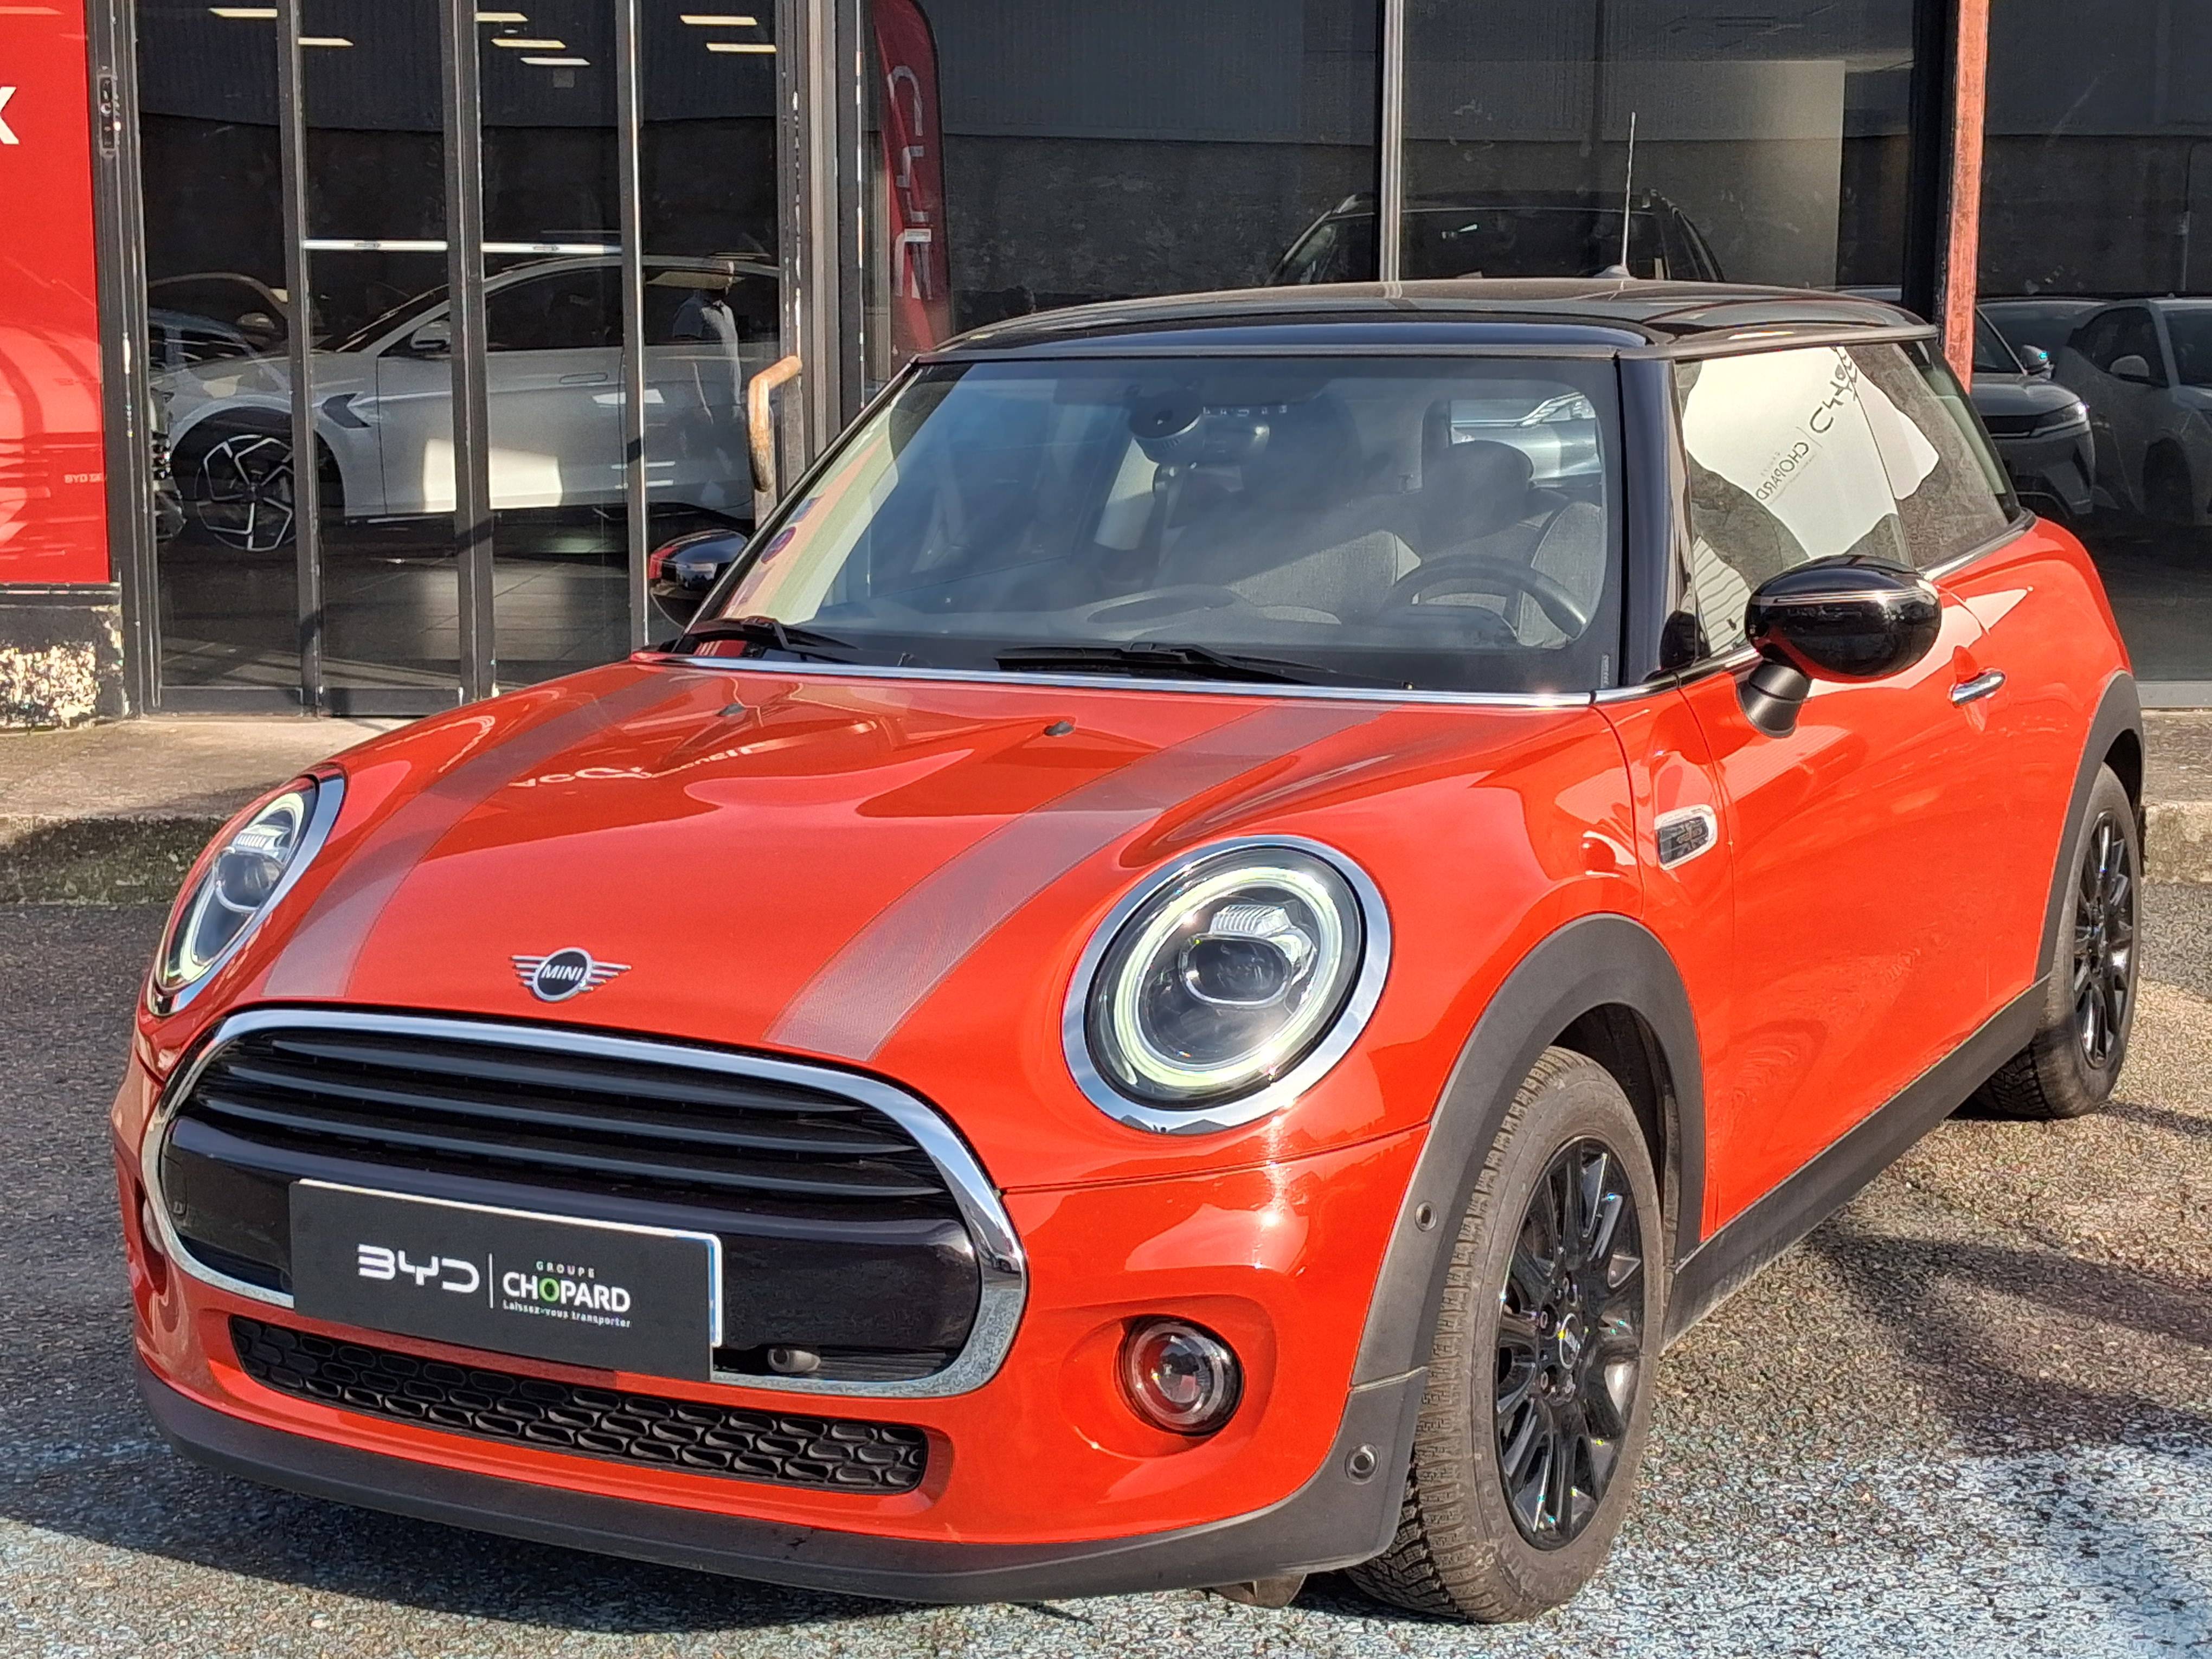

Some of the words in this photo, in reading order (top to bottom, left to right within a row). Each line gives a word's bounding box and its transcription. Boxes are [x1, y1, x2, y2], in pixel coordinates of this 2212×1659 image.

[542, 964, 584, 981] MINI
[358, 1244, 480, 1293] BYD
[536, 1261, 595, 1278] GROUPE
[503, 1272, 631, 1313] CHOPARD
[503, 1300, 569, 1319] Laissez-vous
[571, 1309, 632, 1328] transporter
